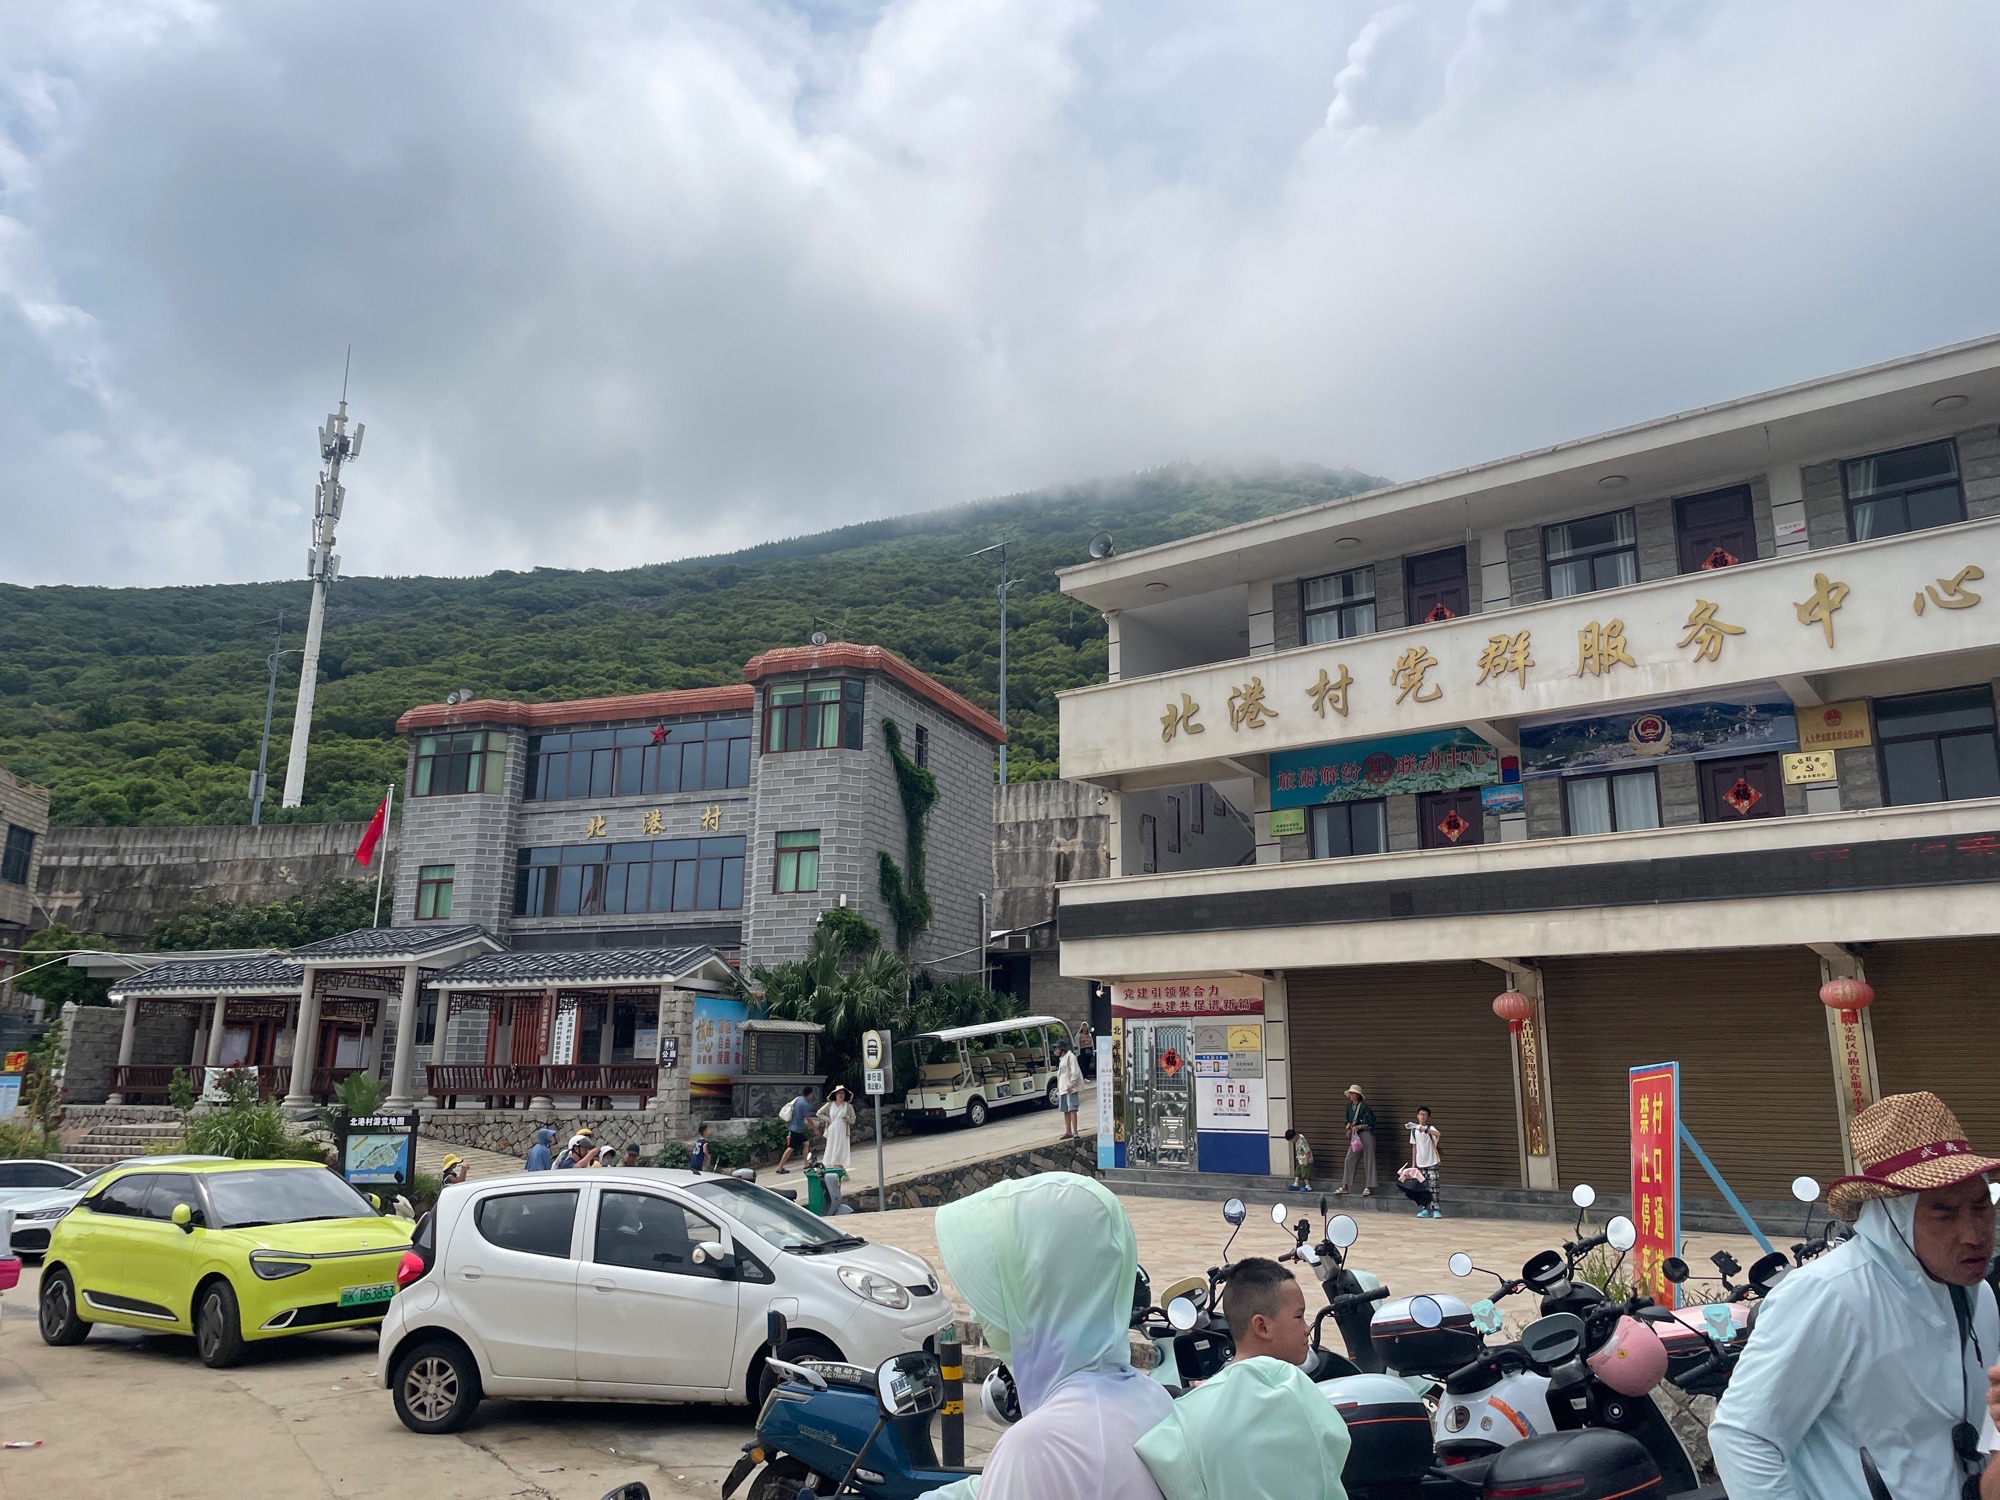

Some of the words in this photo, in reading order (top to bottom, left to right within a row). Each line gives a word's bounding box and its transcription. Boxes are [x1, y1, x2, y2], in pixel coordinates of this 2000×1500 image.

[1159, 565, 1985, 742] 北港村党群服务中心
[1805, 729, 1864, 745] 人大代表联系群众活动室
[1277, 761, 1362, 791] 旅游解纷
[1396, 746, 1491, 775] 联动中心
[585, 804, 722, 838] 北港村
[1123, 985, 1220, 1000] 党建引领聚合力
[1151, 998, 1250, 1013] 共建共促谱新篇
[540, 1010, 549, 1050] 游客服务中心
[662, 1050, 676, 1058] 公厕
[867, 1072, 882, 1082] 单行道
[349, 1117, 405, 1126] 北港村游览地图
[1639, 1094, 1651, 1287] 禁止停车
[1653, 1092, 1665, 1293] 村口通道
